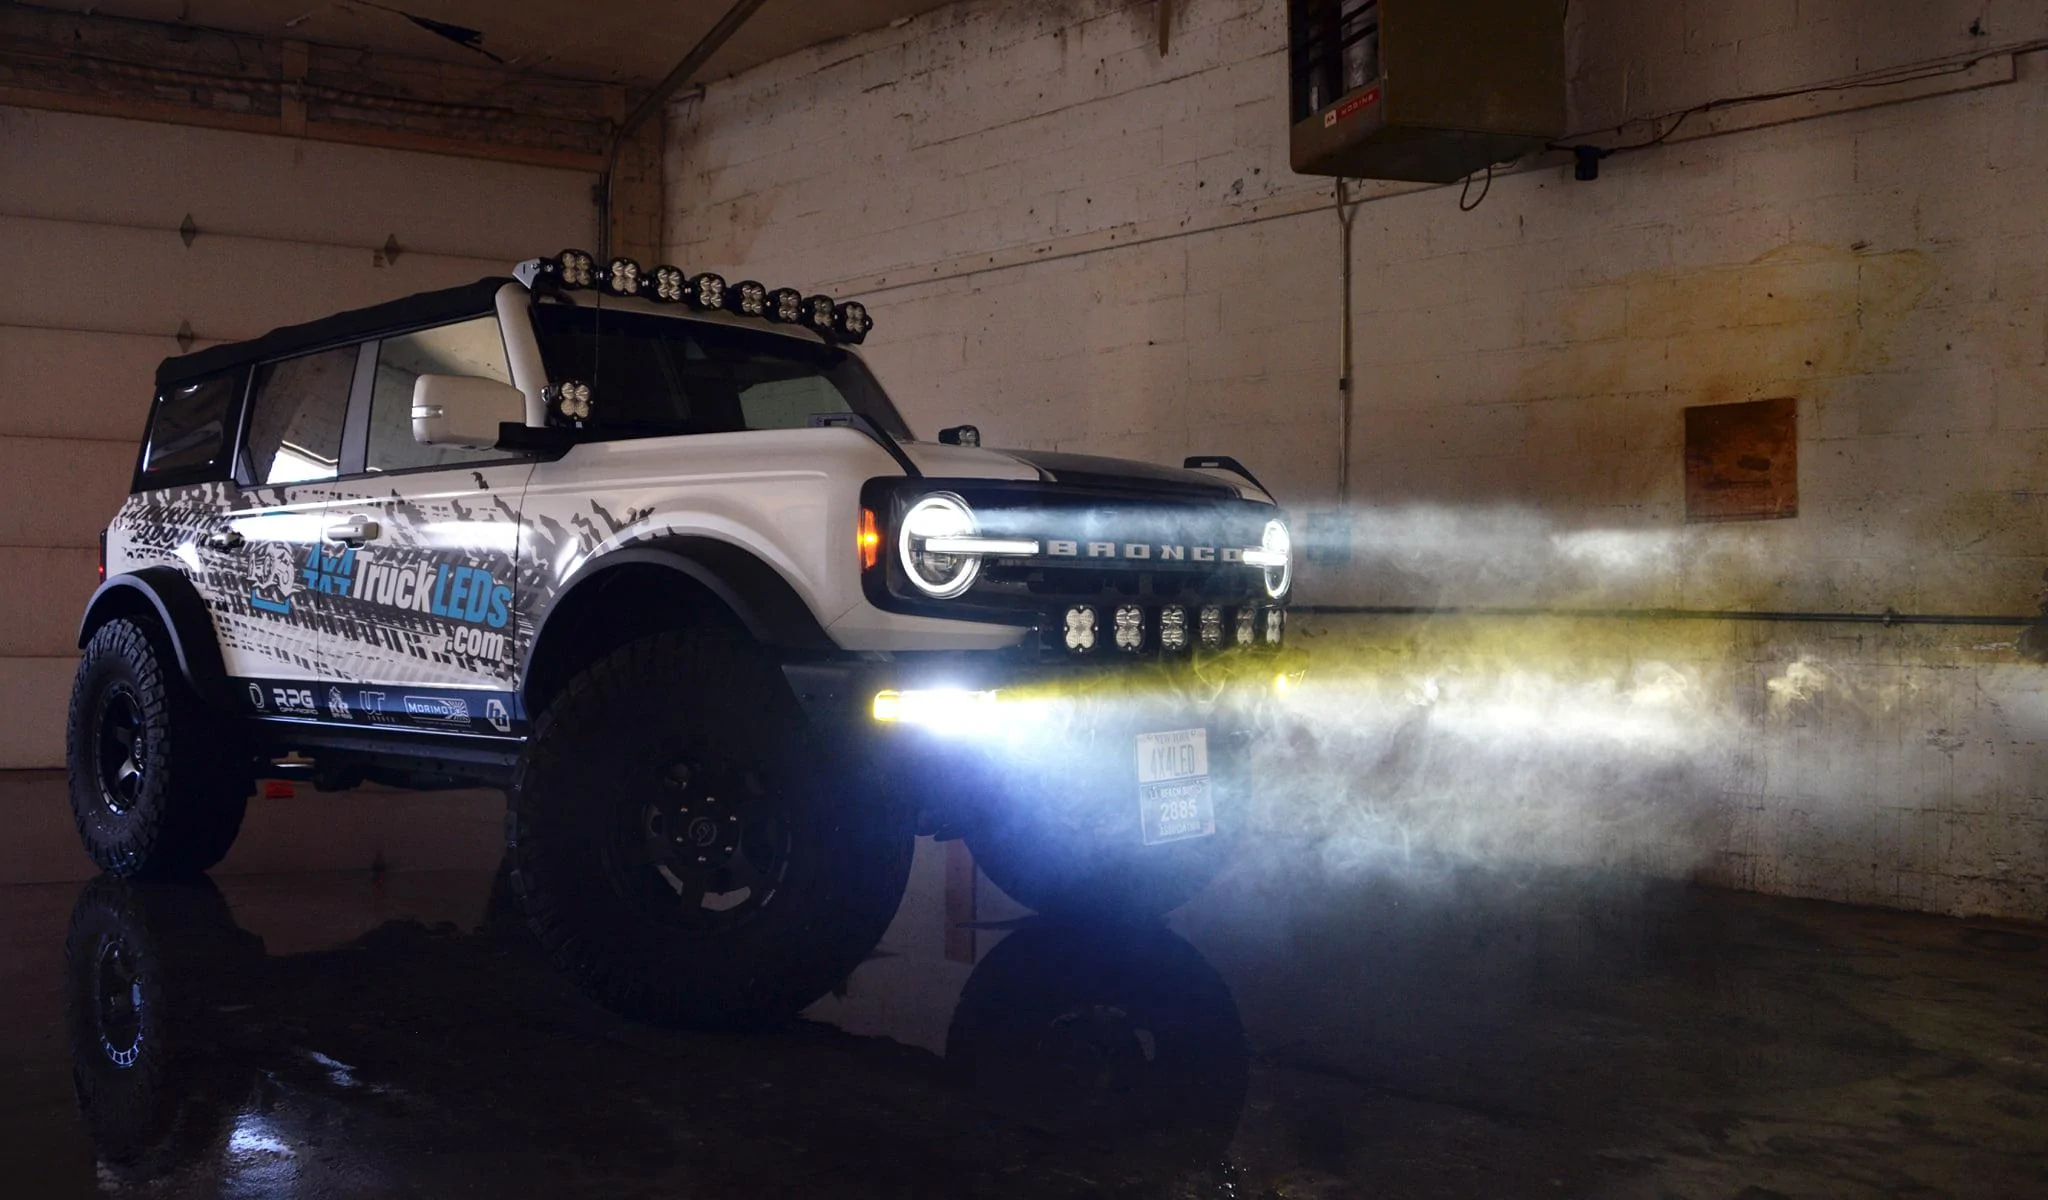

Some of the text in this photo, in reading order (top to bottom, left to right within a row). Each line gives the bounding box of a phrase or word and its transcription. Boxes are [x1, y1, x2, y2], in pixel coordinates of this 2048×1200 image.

[1047, 540, 1245, 562] BRONCO
[448, 625, 504, 662] .com
[273, 688, 315, 709] RPG
[1160, 799, 1198, 822] 2885
